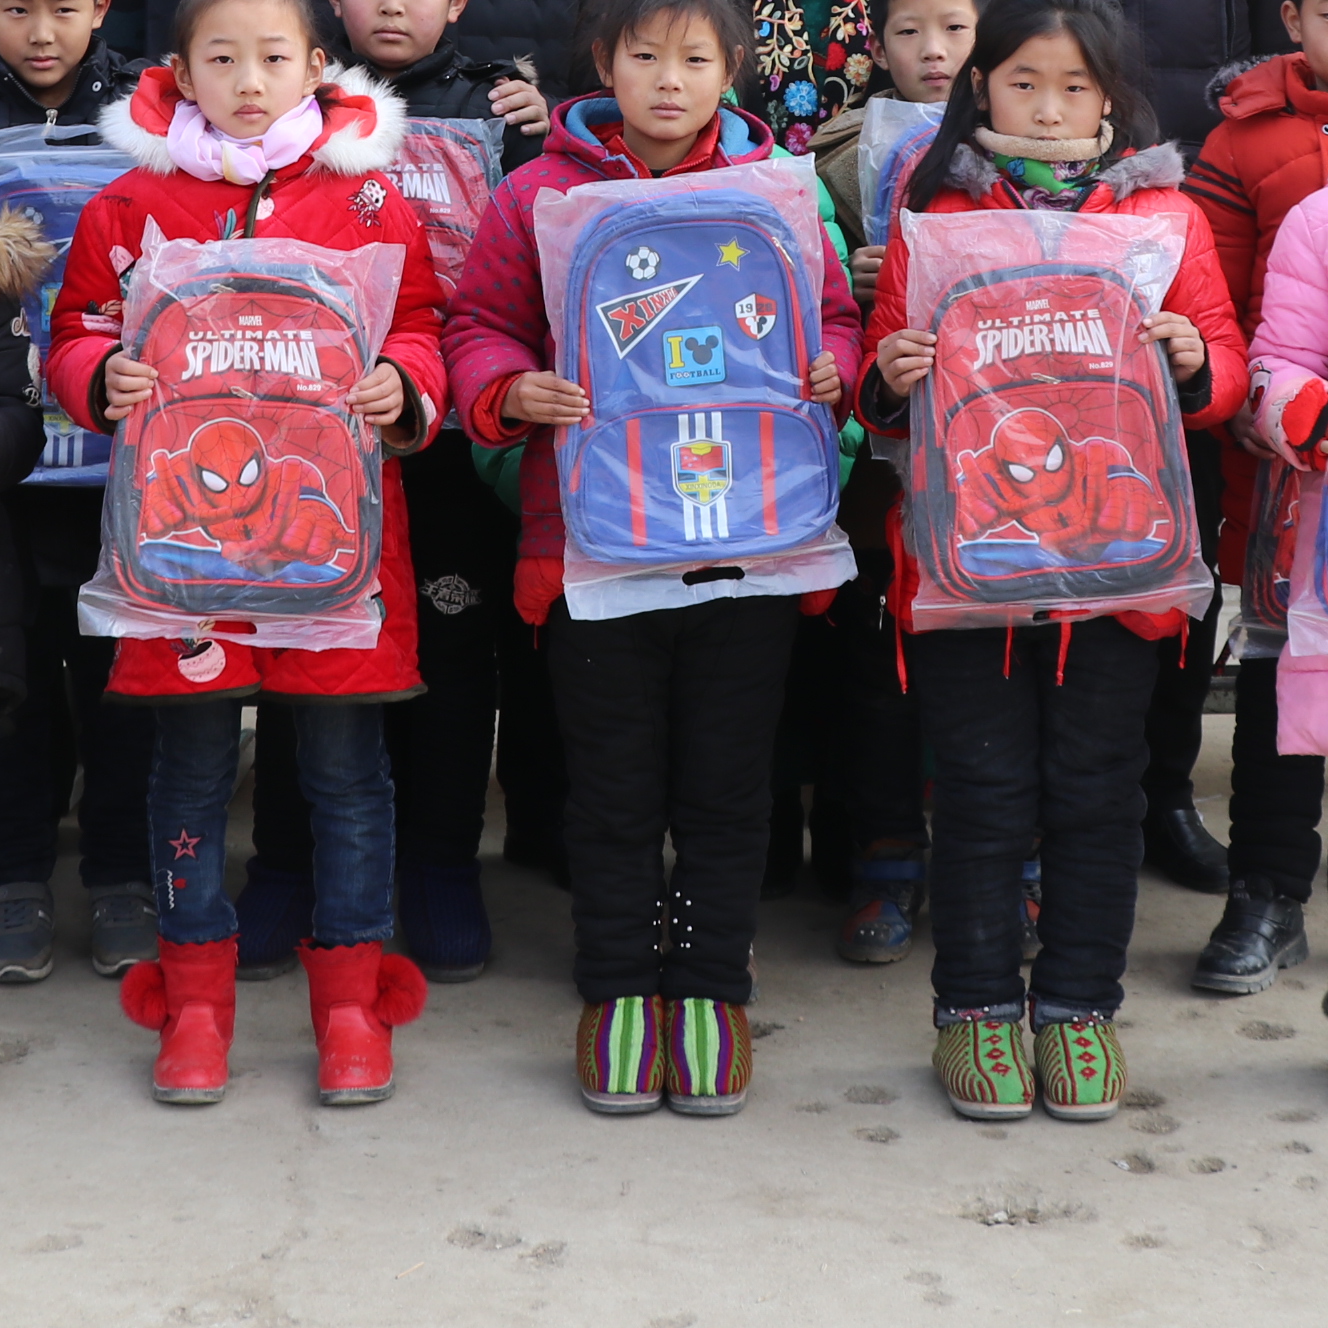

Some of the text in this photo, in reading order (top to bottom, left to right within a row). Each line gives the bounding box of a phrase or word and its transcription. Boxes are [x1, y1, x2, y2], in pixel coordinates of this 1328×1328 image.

[1025, 299, 1050, 311] MARVEL
[238, 315, 263, 326] MARVEL
[978, 309, 1101, 329] ULTIMATE
[189, 330, 313, 340] ULTIMATE
[973, 319, 1113, 370] SPIDER-MAN
[667, 336, 685, 368] I
[181, 341, 322, 380] SPIDER-MAN
[1089, 361, 1114, 370] No.829
[670, 369, 721, 380] FOOTBALL
